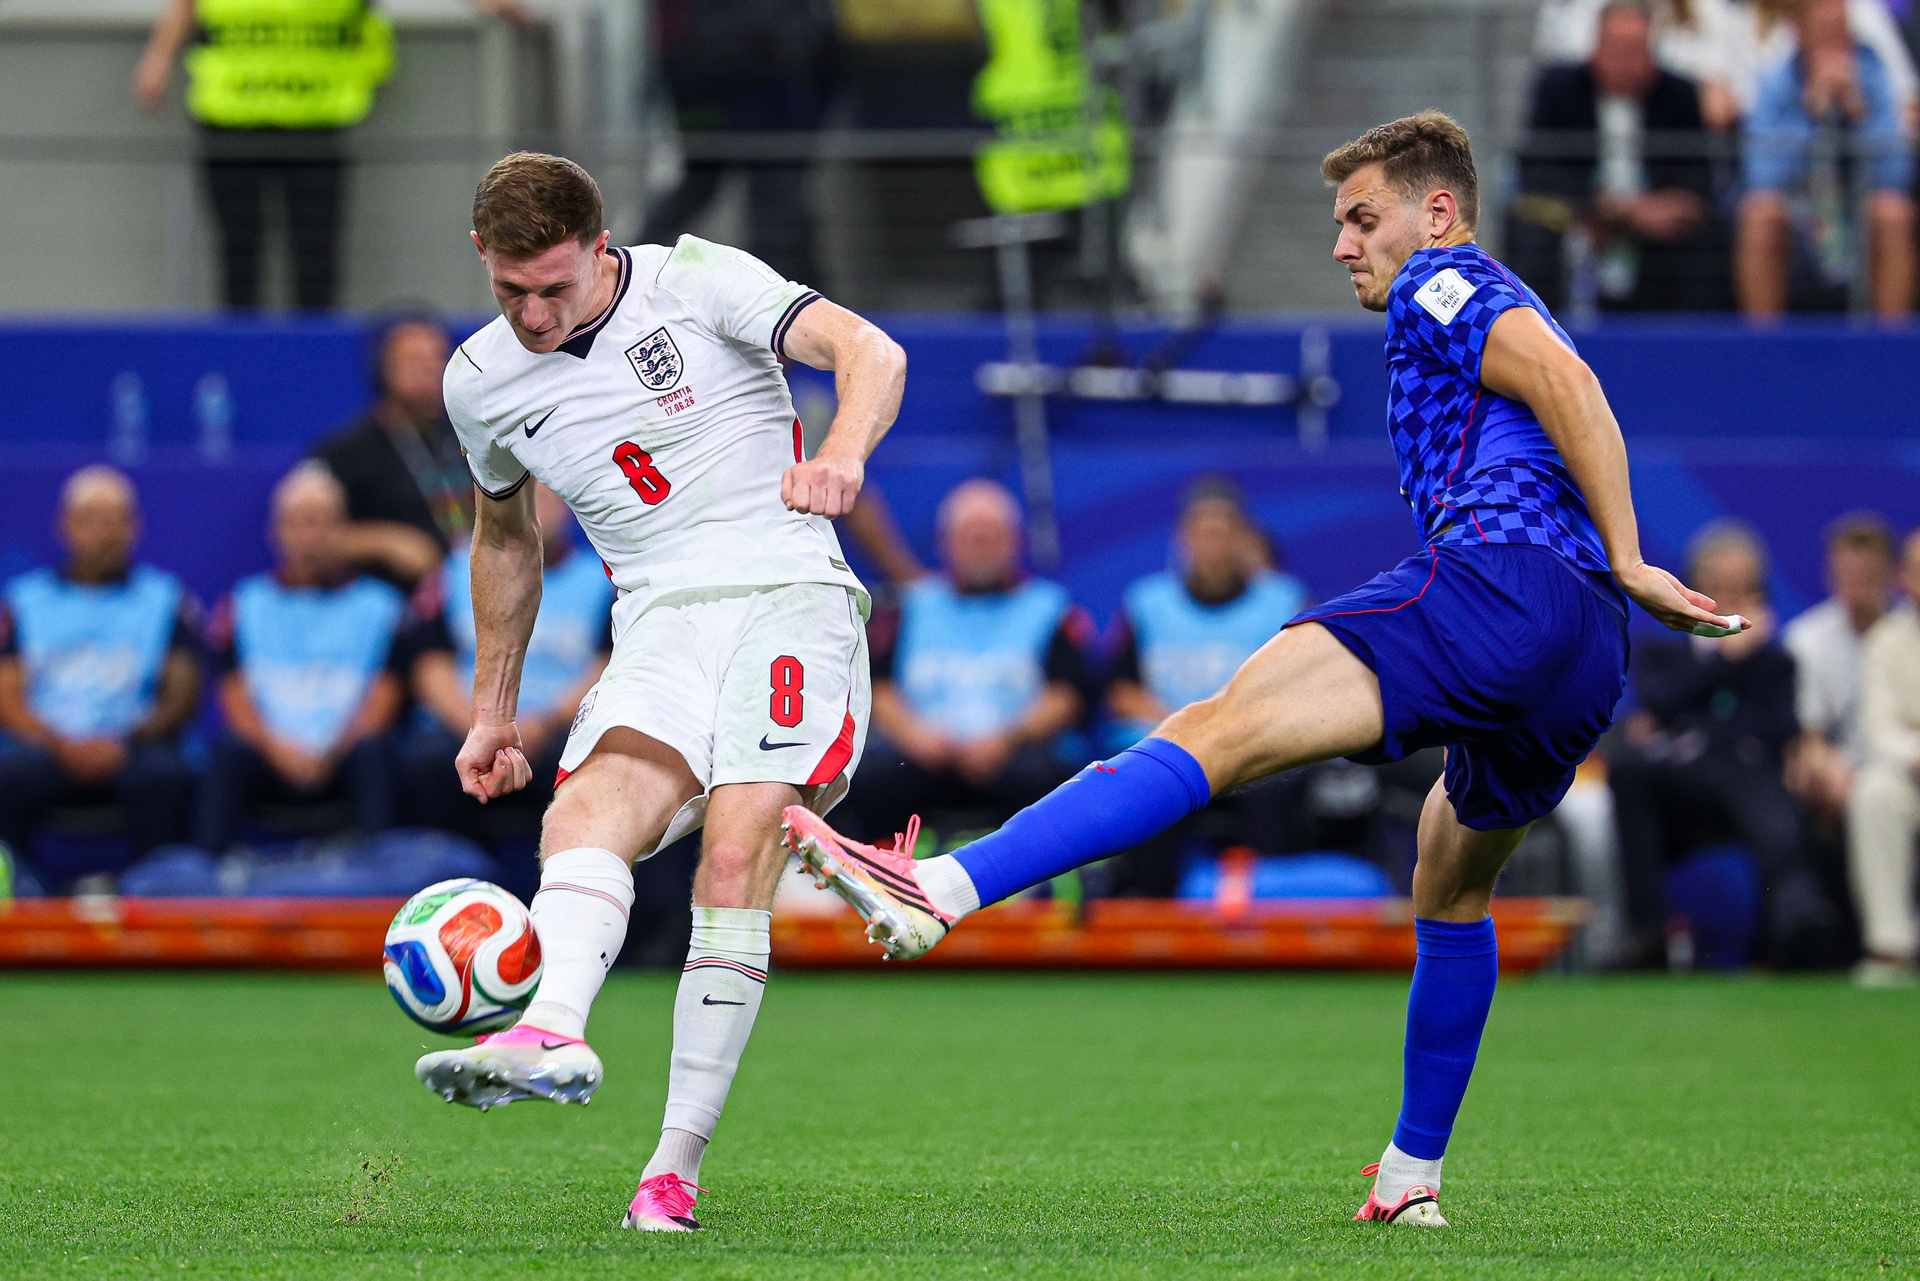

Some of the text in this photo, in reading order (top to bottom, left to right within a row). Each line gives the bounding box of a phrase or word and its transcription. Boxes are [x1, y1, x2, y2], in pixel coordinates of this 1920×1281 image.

[1441, 289, 1460, 308] PEACE
[656, 386, 692, 407] CROATIA
[664, 396, 695, 416] 17.06.26
[612, 441, 671, 505] 8
[770, 655, 804, 728] 8
